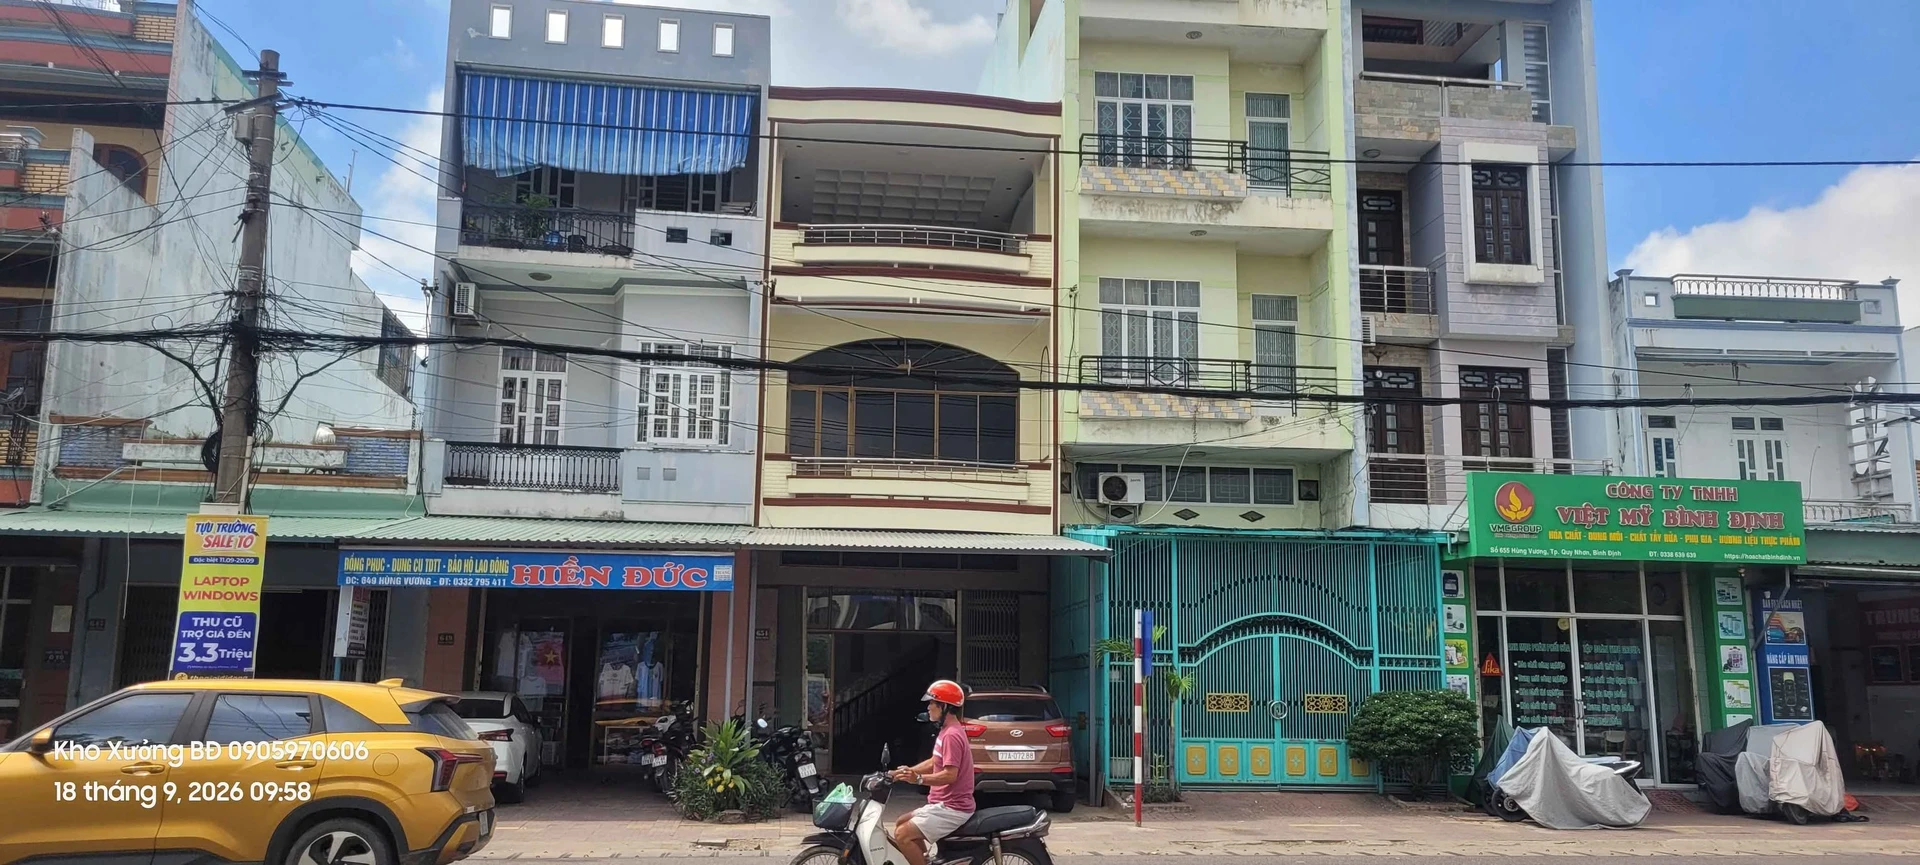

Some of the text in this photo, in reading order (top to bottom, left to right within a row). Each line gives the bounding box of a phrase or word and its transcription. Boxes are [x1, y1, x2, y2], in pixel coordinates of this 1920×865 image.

[1606, 481, 1738, 501] CÔNG TY TNHH
[1555, 502, 1785, 533] VIỆT MỸ BÌNH ĐỊNH
[195, 518, 256, 535] TỰU TRƯỜNG
[202, 534, 255, 549] SALE TO
[1565, 527, 1582, 540] CHẤT
[1630, 529, 1647, 542] CHẤT
[1490, 545, 1498, 553] Số
[1511, 547, 1527, 555] Hùng
[1561, 549, 1573, 557] Quy
[366, 557, 385, 575] PHỤC
[391, 557, 412, 575] DỤNG
[413, 558, 424, 576] CỤ
[425, 558, 441, 573] TDTT
[447, 553, 462, 573] BẢO
[463, 556, 474, 576] HỘ
[475, 559, 488, 573] LAO
[489, 556, 510, 577] ĐỘNG
[511, 555, 708, 588] HIỀN ĐỨC
[193, 576, 250, 587] LAPTOP
[345, 576, 359, 585] ĐC:
[361, 576, 377, 585] 649
[378, 574, 402, 585] HÙNG
[403, 575, 431, 586] VƯƠNG
[439, 577, 451, 586] ĐT:
[453, 578, 473, 586] 0332
[475, 578, 490, 586] 795
[491, 578, 506, 586] 411
[183, 590, 259, 601] WINDOWS
[192, 615, 242, 627] THU CŨ
[181, 628, 251, 640] TRỢ GIÁ ĐẾN
[177, 642, 253, 662] 3.3 Triệu
[1481, 659, 1500, 674] Sika
